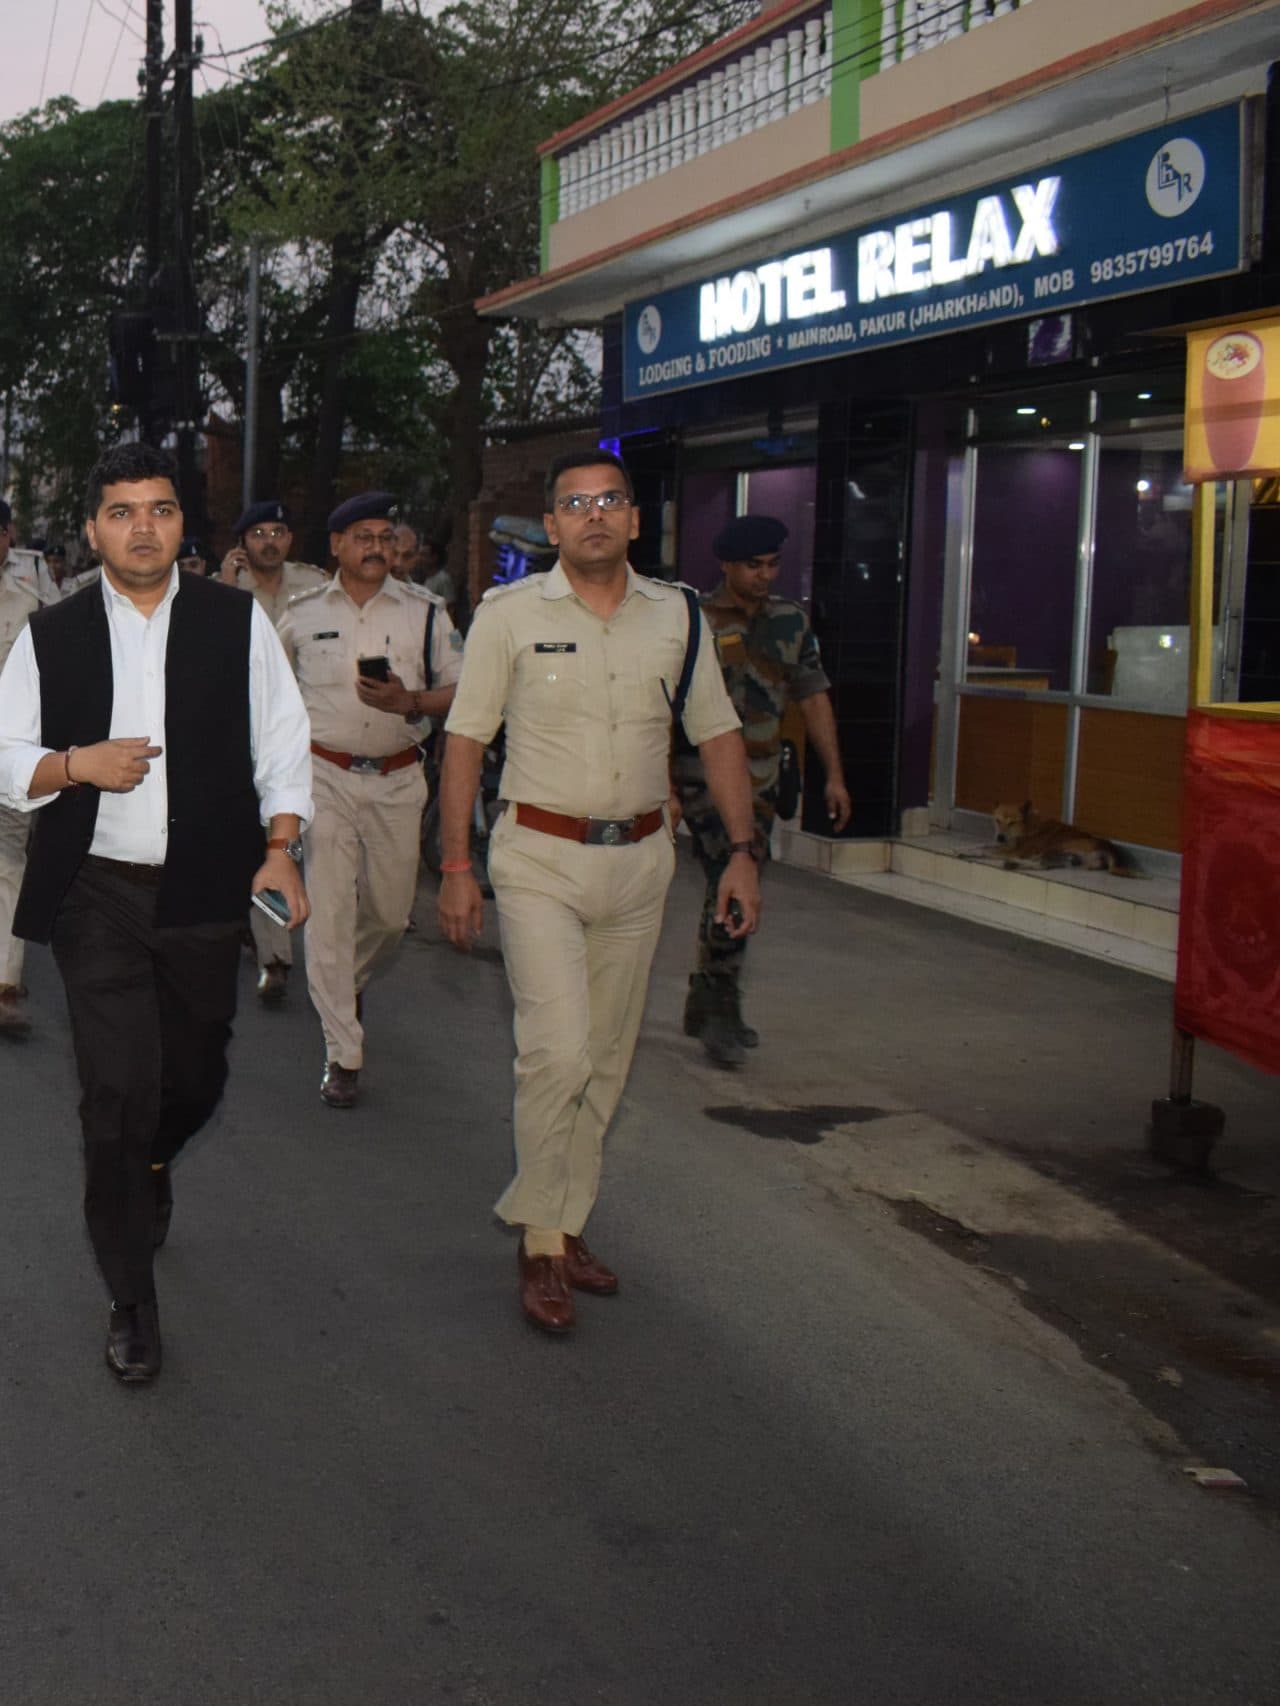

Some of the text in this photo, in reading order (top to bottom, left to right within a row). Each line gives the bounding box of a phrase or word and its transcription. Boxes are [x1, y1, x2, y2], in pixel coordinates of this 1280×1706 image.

[639, 355, 692, 386] LODGING
[695, 352, 705, 373] &
[708, 334, 771, 370] FOODING
[859, 311, 906, 337] PAKUR
[1034, 269, 1074, 298] MOB
[1090, 231, 1214, 283] 9835799764
[699, 176, 1061, 342] HOTEL RELAX
